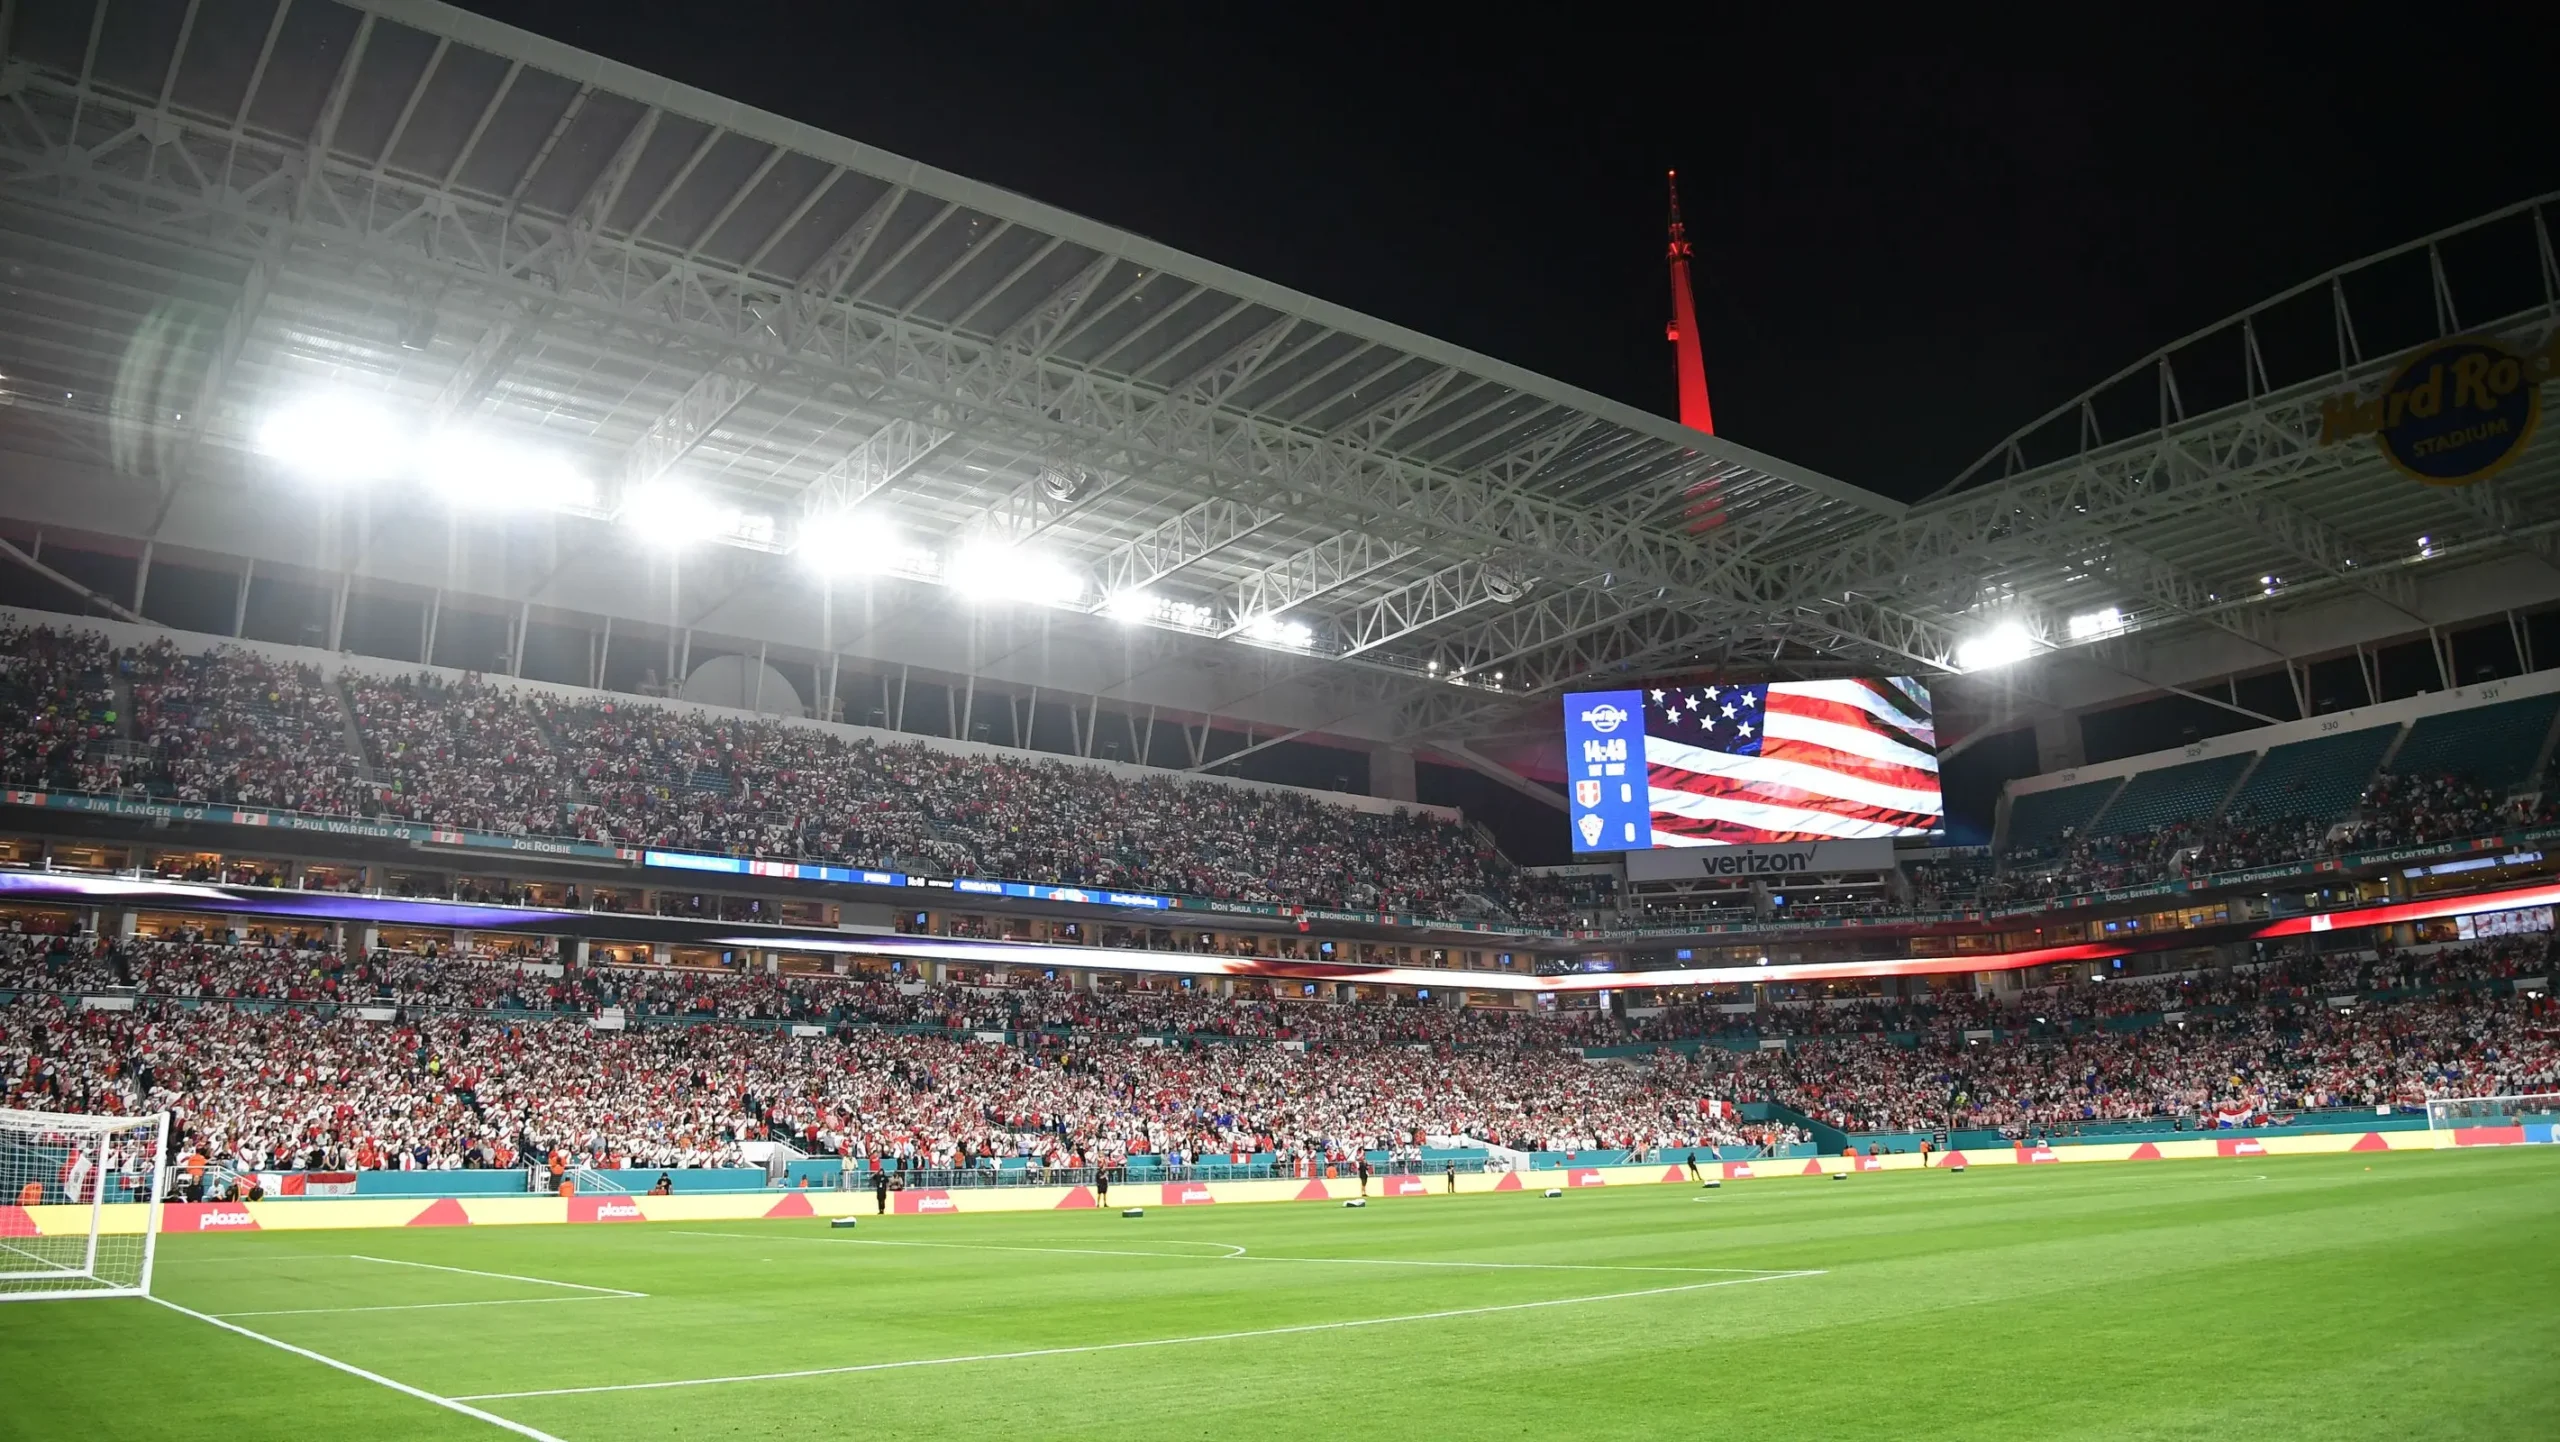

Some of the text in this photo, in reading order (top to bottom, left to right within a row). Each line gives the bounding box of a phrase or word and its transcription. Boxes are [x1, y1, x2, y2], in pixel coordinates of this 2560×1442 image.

[2318, 364, 2443, 447] Hard
[2412, 417, 2509, 458] STADIUM
[2320, 720, 2339, 731] 330
[84, 799, 203, 820] JIM LANGER 62
[294, 818, 411, 840] PAUL WARFIELD 42
[512, 838, 571, 854] JOE ROBBIE
[2361, 843, 2453, 866] MARK CLAYTON 83
[1702, 849, 1806, 875] verizon
[2218, 877, 2242, 886] JOHN
[2289, 866, 2302, 875] 56
[2160, 885, 2172, 894] 75
[1211, 902, 1228, 911] DON
[1230, 903, 1251, 913] SHULA
[200, 1208, 252, 1230] plaza
[597, 1201, 639, 1221] plaza
